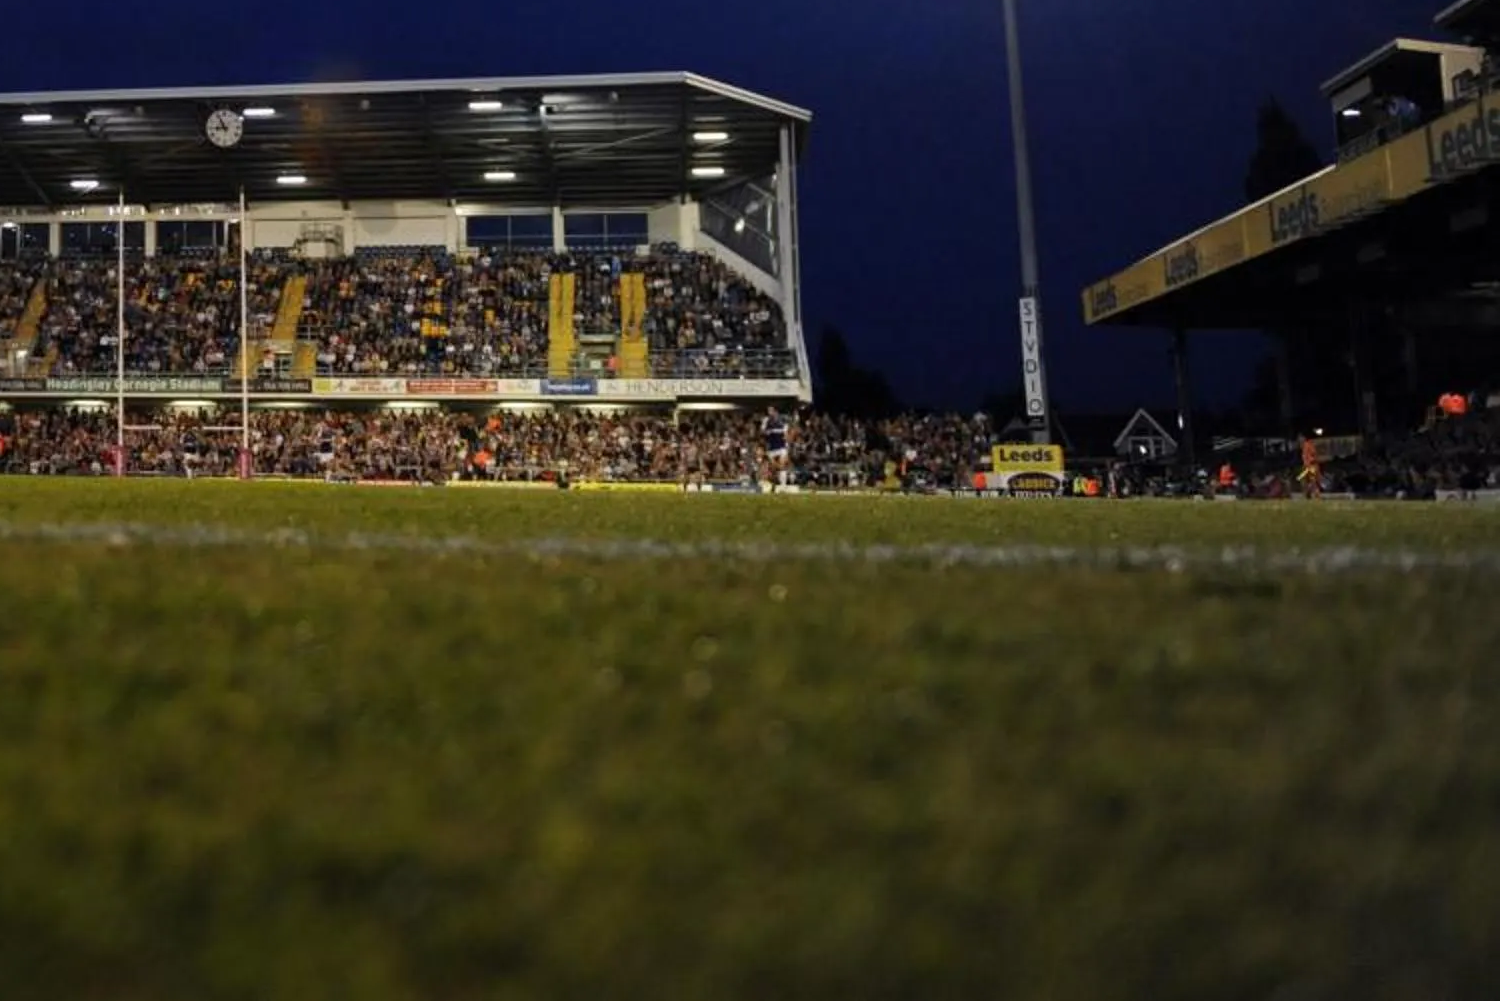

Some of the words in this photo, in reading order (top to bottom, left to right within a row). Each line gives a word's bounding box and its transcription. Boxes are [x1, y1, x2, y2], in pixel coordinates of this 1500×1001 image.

[46, 378, 112, 392] Headingley
[169, 378, 221, 390] Stadium
[1000, 447, 1053, 462] Leeds
